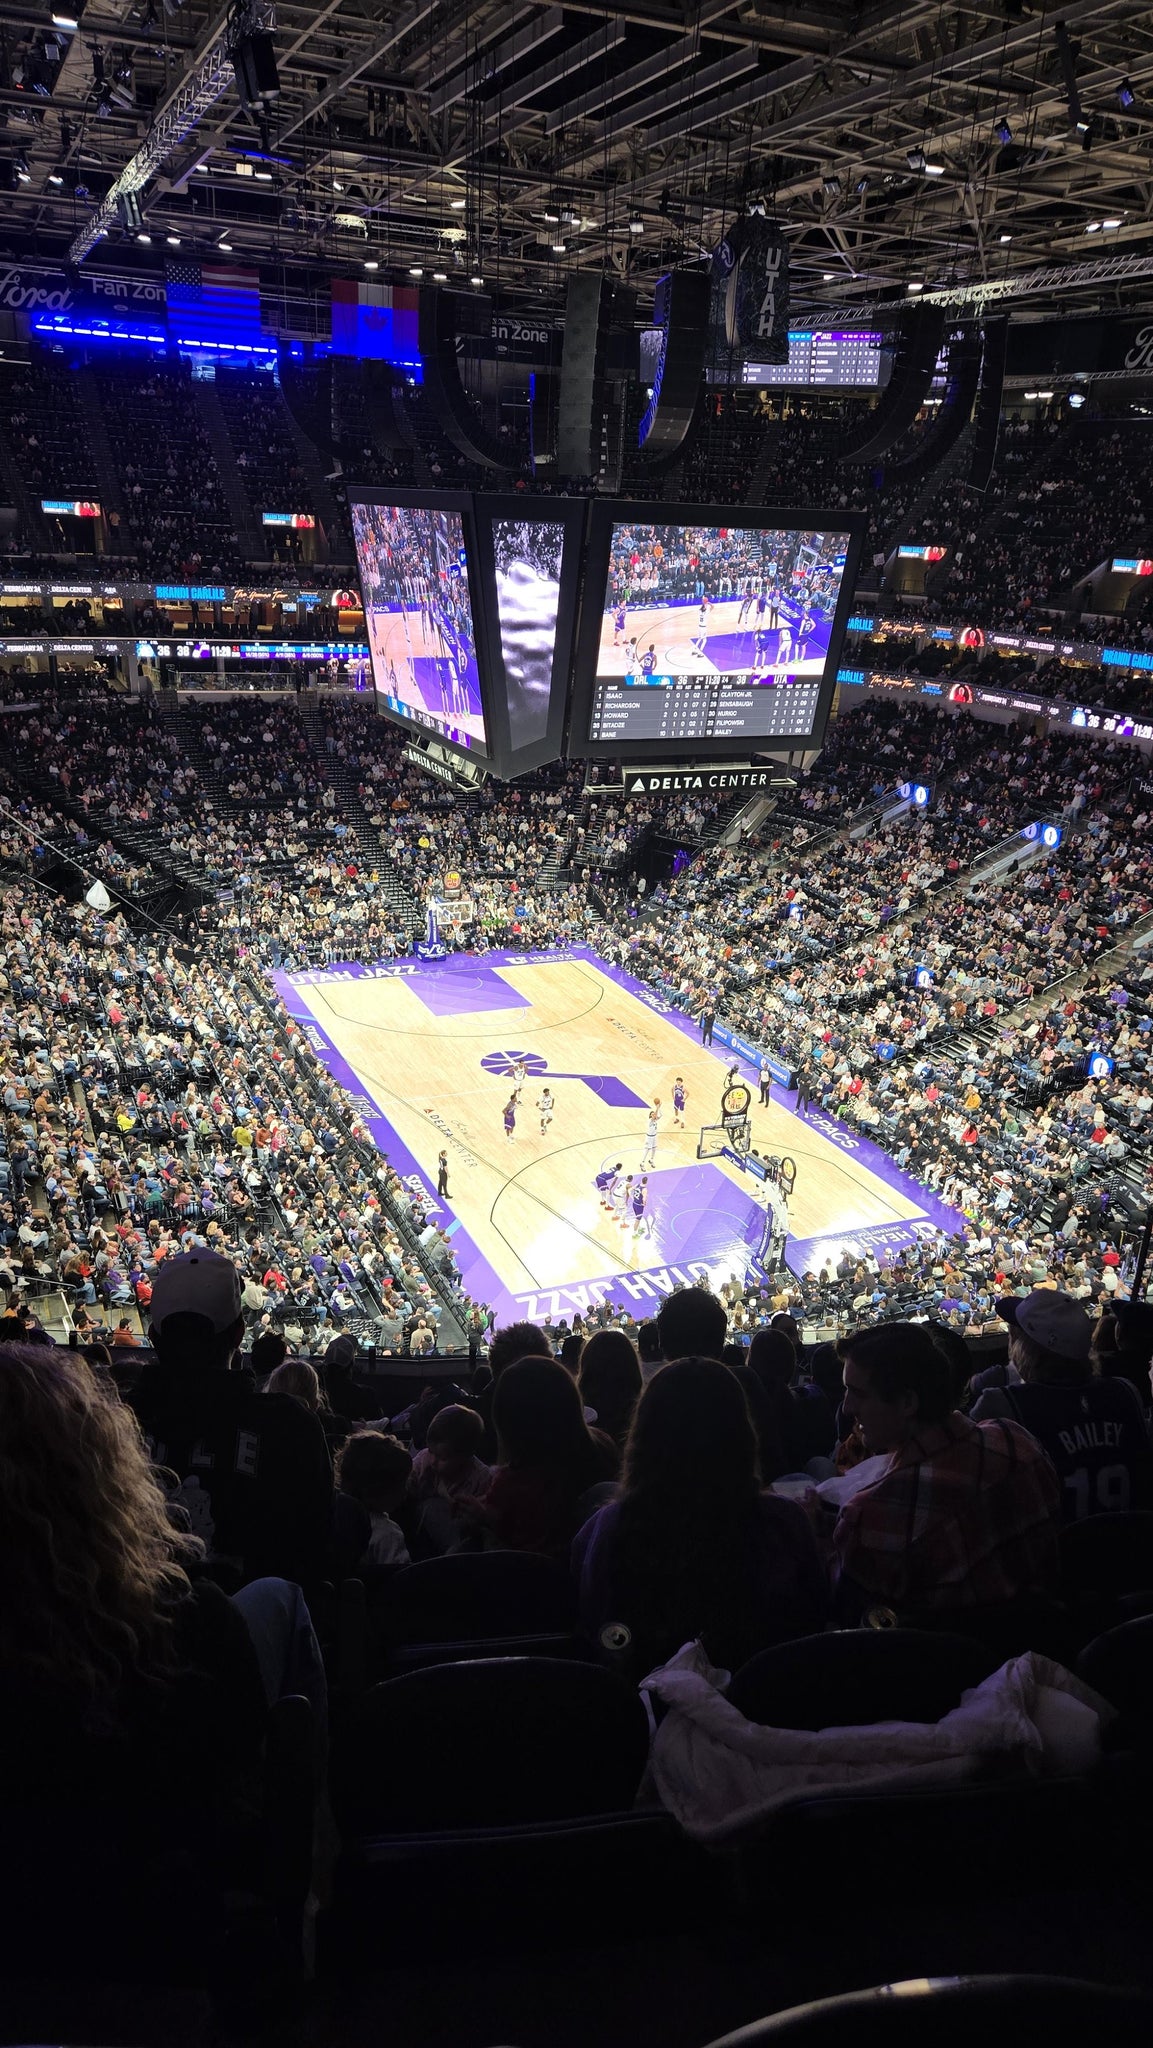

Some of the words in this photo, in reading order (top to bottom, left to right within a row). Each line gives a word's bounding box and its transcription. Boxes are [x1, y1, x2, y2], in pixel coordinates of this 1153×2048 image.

[92, 279, 128, 296] Fan
[132, 284, 167, 302] Zon
[758, 247, 782, 337] UTAH
[511, 325, 549, 343] Zone
[4, 585, 32, 593] FEBRUARY
[156, 586, 189, 599] BRANDI
[191, 587, 226, 600] CARLILE
[626, 603, 670, 612] PACS
[157, 645, 170, 657] 36
[177, 645, 190, 657] 38
[1103, 649, 1130, 666] BRANDI
[634, 676, 648, 685] ORL
[736, 676, 746, 684] 38
[774, 675, 787, 684] UTA
[1088, 715, 1100, 728] 36
[1103, 718, 1116, 731] 38
[413, 751, 431, 770] DELTA
[431, 761, 452, 782] CENTER
[650, 777, 703, 790] DELTA
[709, 774, 767, 788] CENTER
[287, 971, 358, 985] UTAH
[359, 965, 422, 979] JAZZ
[430, 1114, 455, 1138] DELTA
[815, 1119, 860, 1149] PACS
[858, 1230, 913, 1248] HEALT
[618, 1261, 714, 1300] UTAH
[515, 1281, 615, 1321] JAZZ
[1058, 1421, 1123, 1455] BAILEY
[1064, 1464, 1130, 1519] 19
